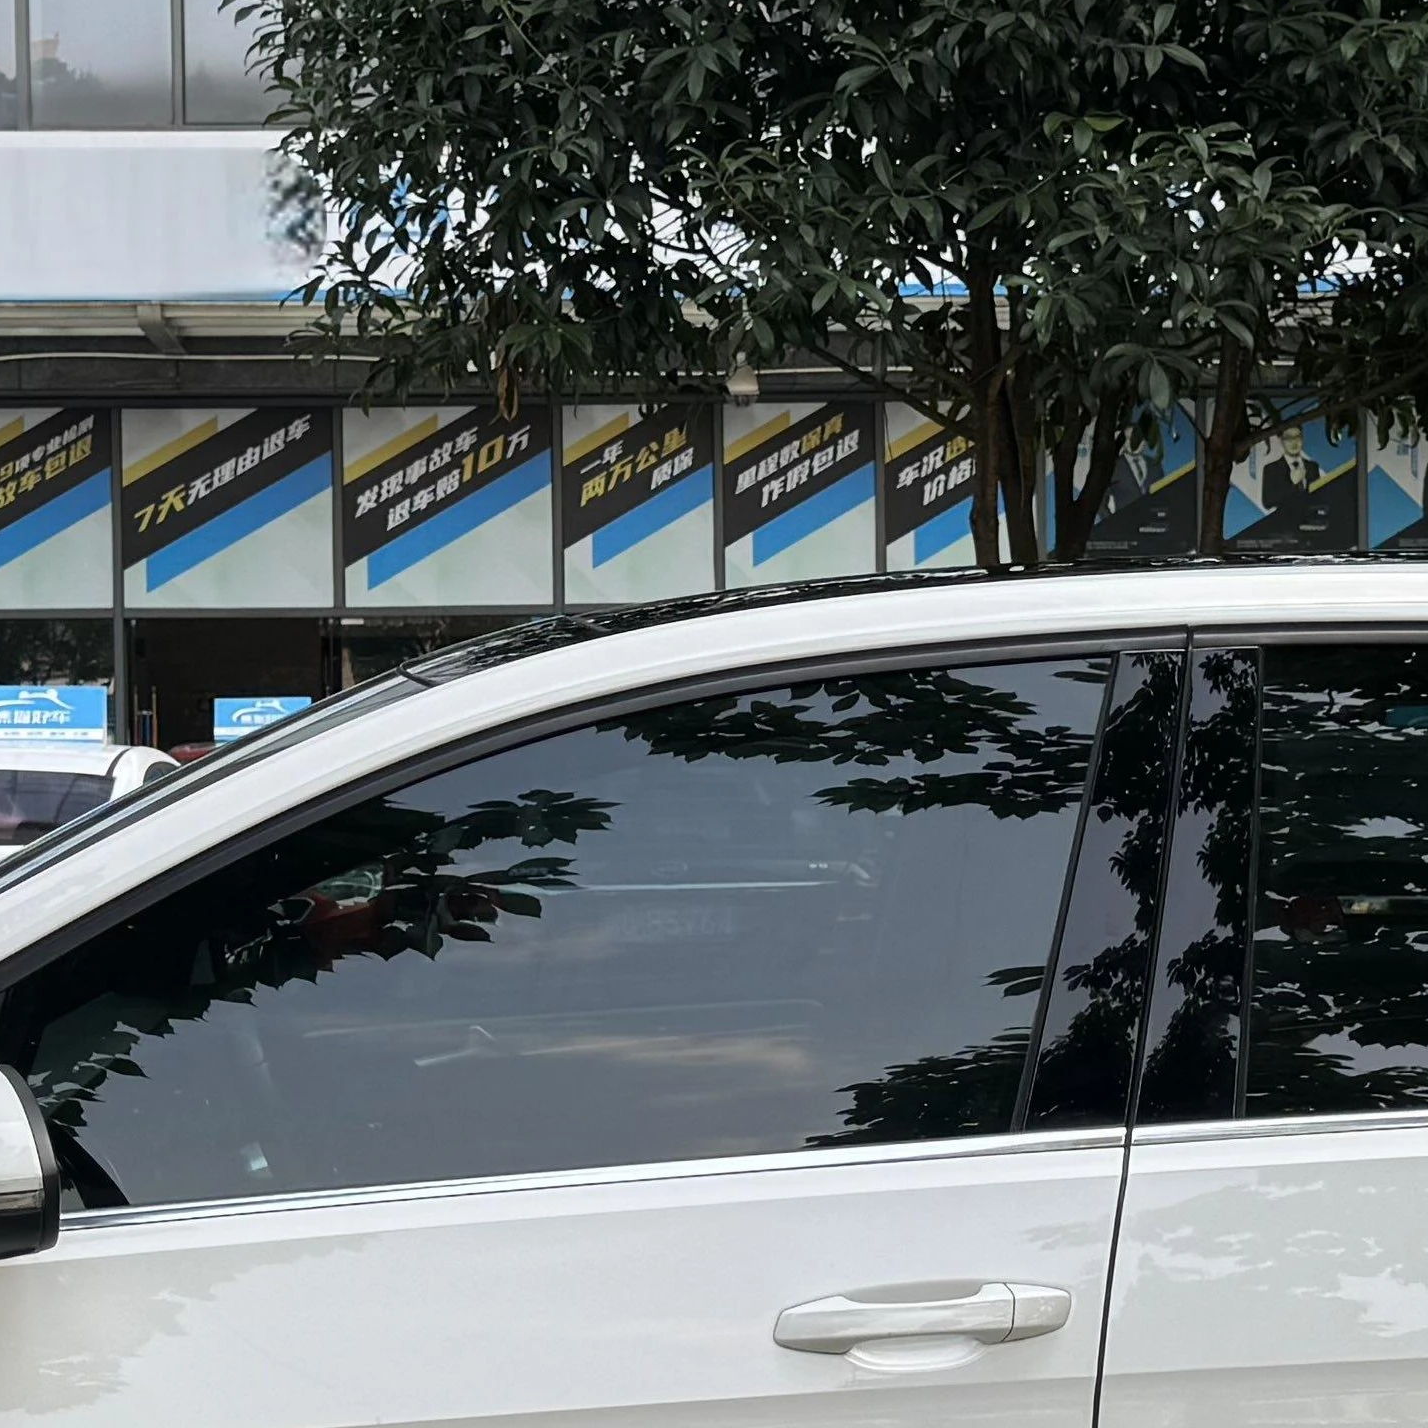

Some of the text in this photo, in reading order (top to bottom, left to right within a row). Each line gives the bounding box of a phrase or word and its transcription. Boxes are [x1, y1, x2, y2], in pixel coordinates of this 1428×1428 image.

[133, 413, 312, 533] 7天无理由退车
[354, 426, 479, 519] 发现事故车
[386, 424, 531, 532] 退车赔10万
[580, 421, 689, 508] 两万公里
[735, 412, 845, 495] 里程数保真
[761, 428, 860, 509] 作假包退
[896, 435, 975, 490] 车况透
[923, 456, 977, 506] 价格
